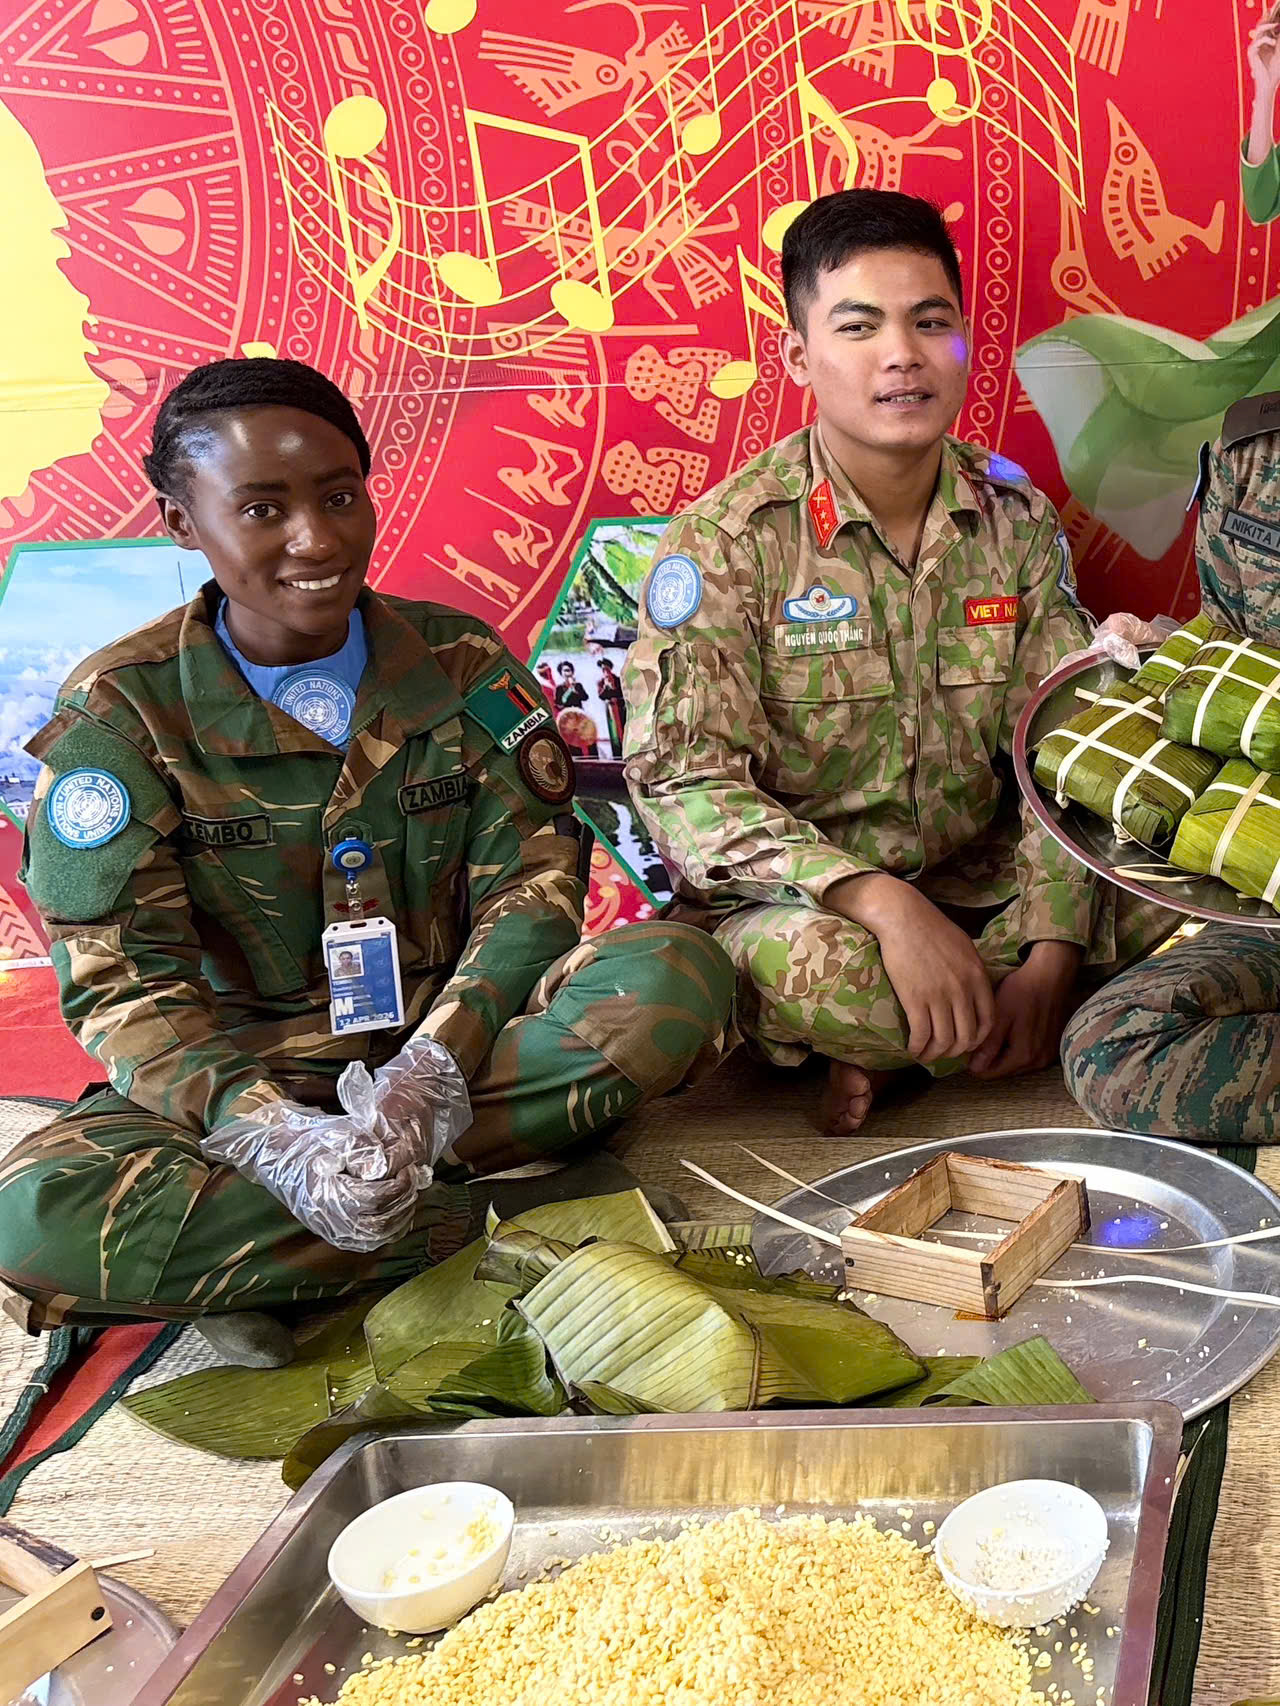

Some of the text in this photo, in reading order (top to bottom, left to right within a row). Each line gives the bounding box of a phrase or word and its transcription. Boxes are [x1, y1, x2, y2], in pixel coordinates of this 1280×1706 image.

[1231, 518, 1272, 545] NIKITA
[970, 604, 1000, 619] VIET
[284, 681, 342, 706] UNITED NATIONS
[328, 719, 346, 738] UNIES
[504, 712, 546, 746] ZAMBIA
[60, 776, 120, 817] UNITED NATIONS
[56, 801, 111, 839] NATIONS UNIES
[335, 997, 354, 1016] M
